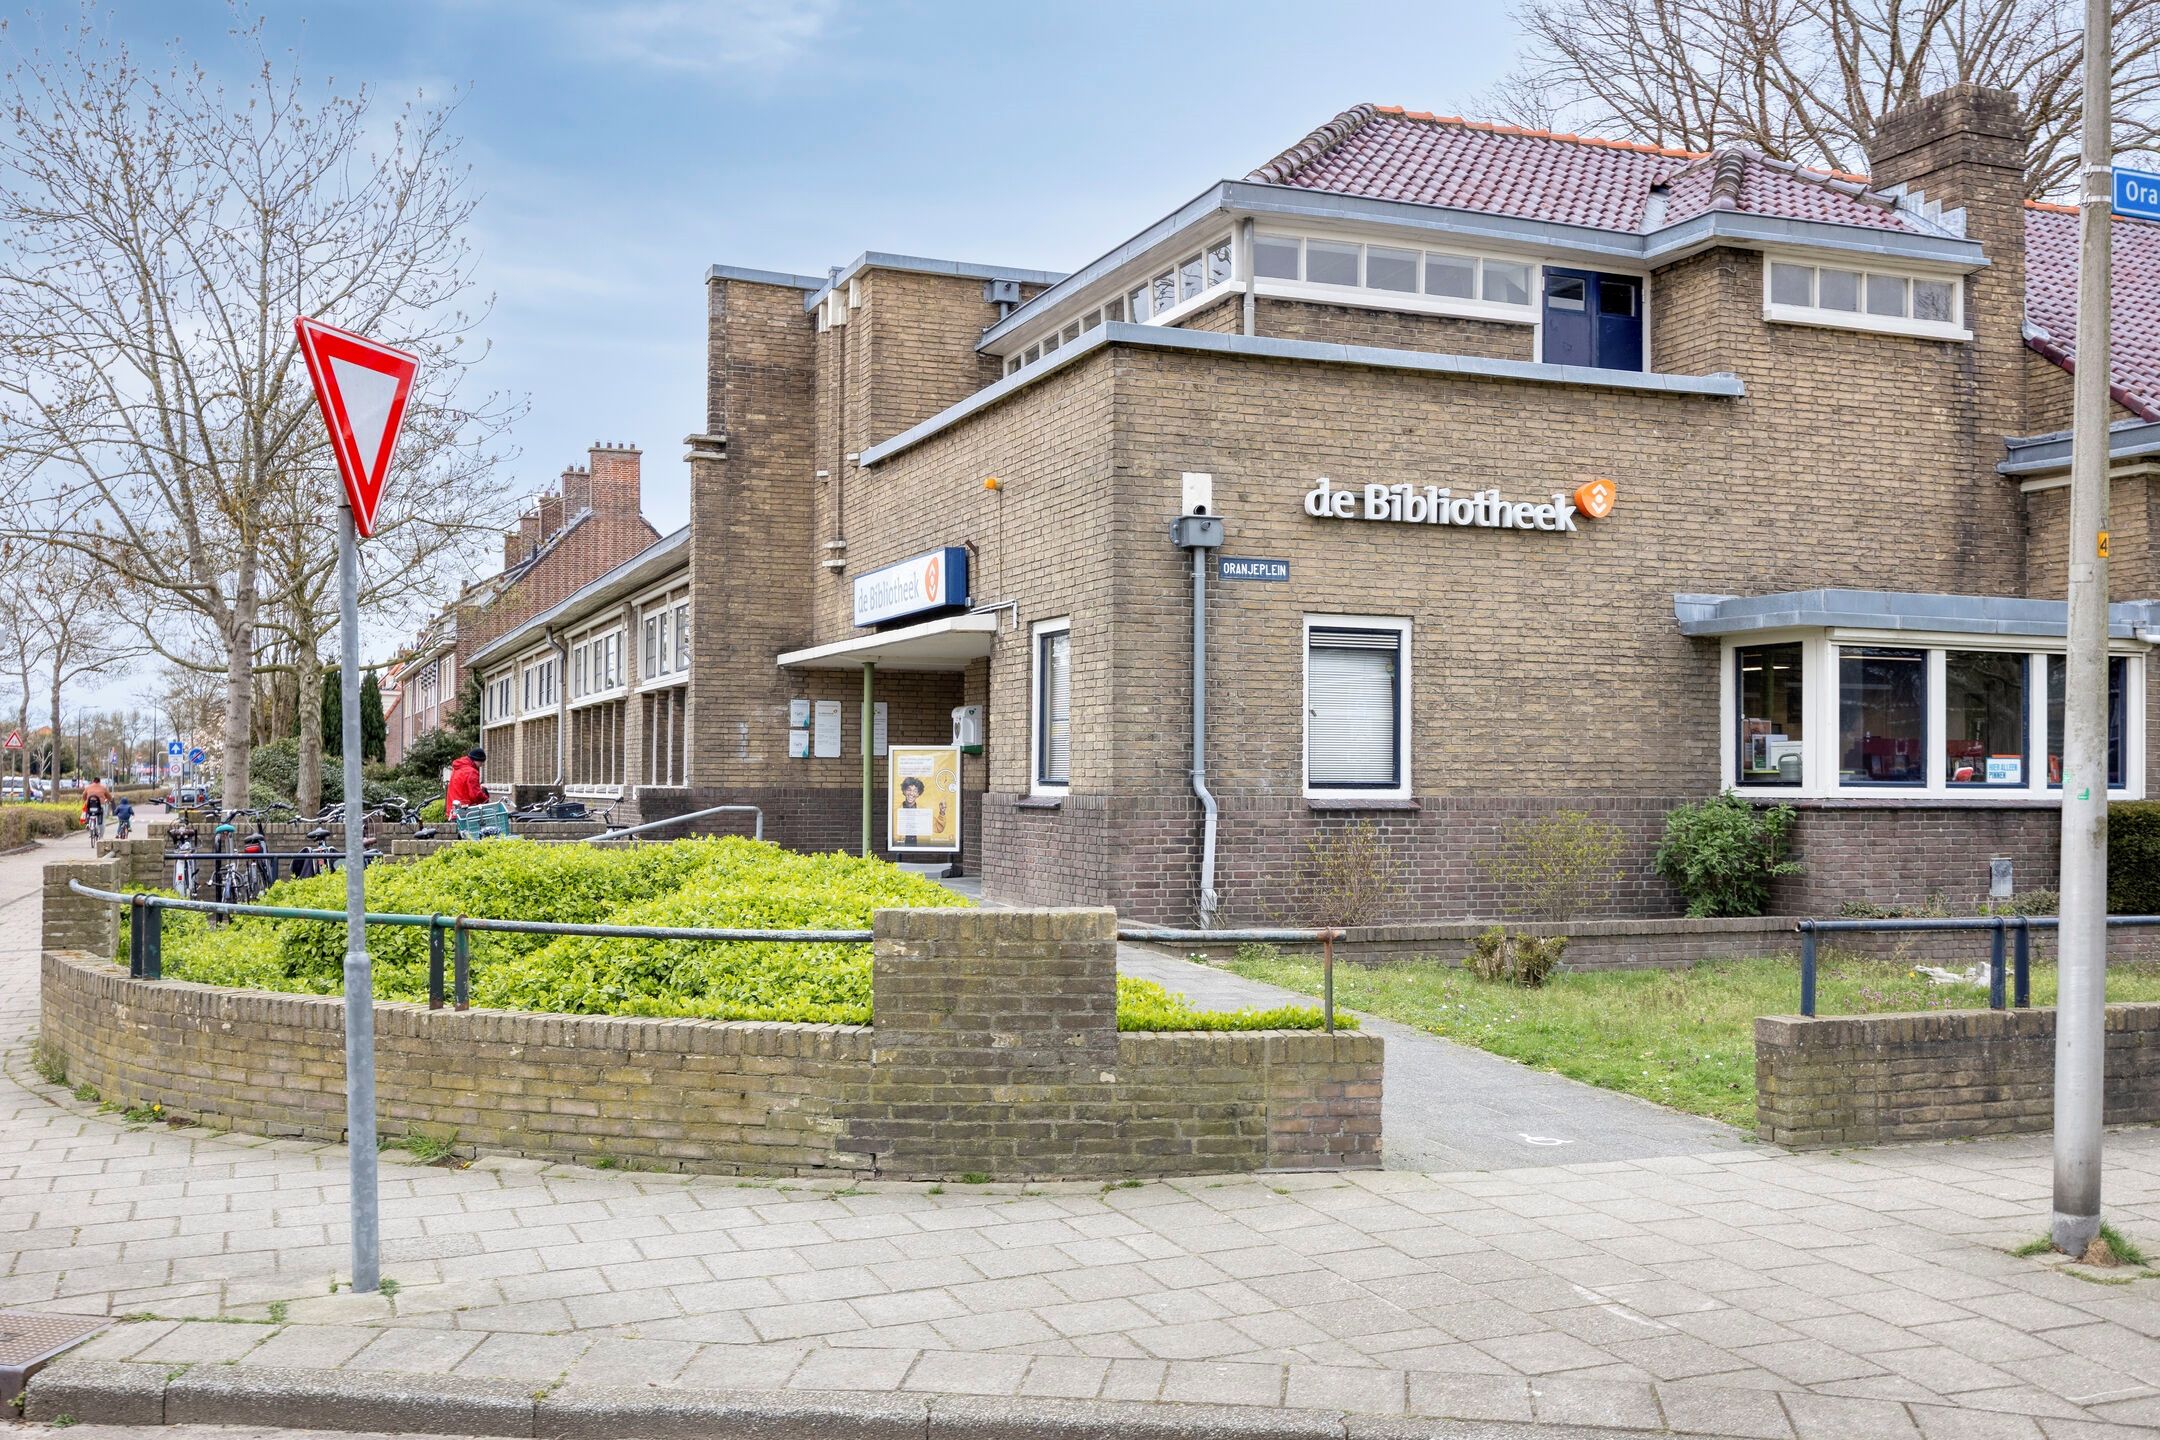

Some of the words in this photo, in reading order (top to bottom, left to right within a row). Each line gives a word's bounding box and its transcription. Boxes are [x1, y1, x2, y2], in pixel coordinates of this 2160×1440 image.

[1304, 477, 1355, 519] de
[1364, 483, 1577, 532] Bibliotheek
[2099, 537, 2108, 553] 4
[1223, 562, 1287, 577] ORANJEPLEIN
[858, 587, 868, 614] de
[870, 571, 920, 611] Bibliotheek
